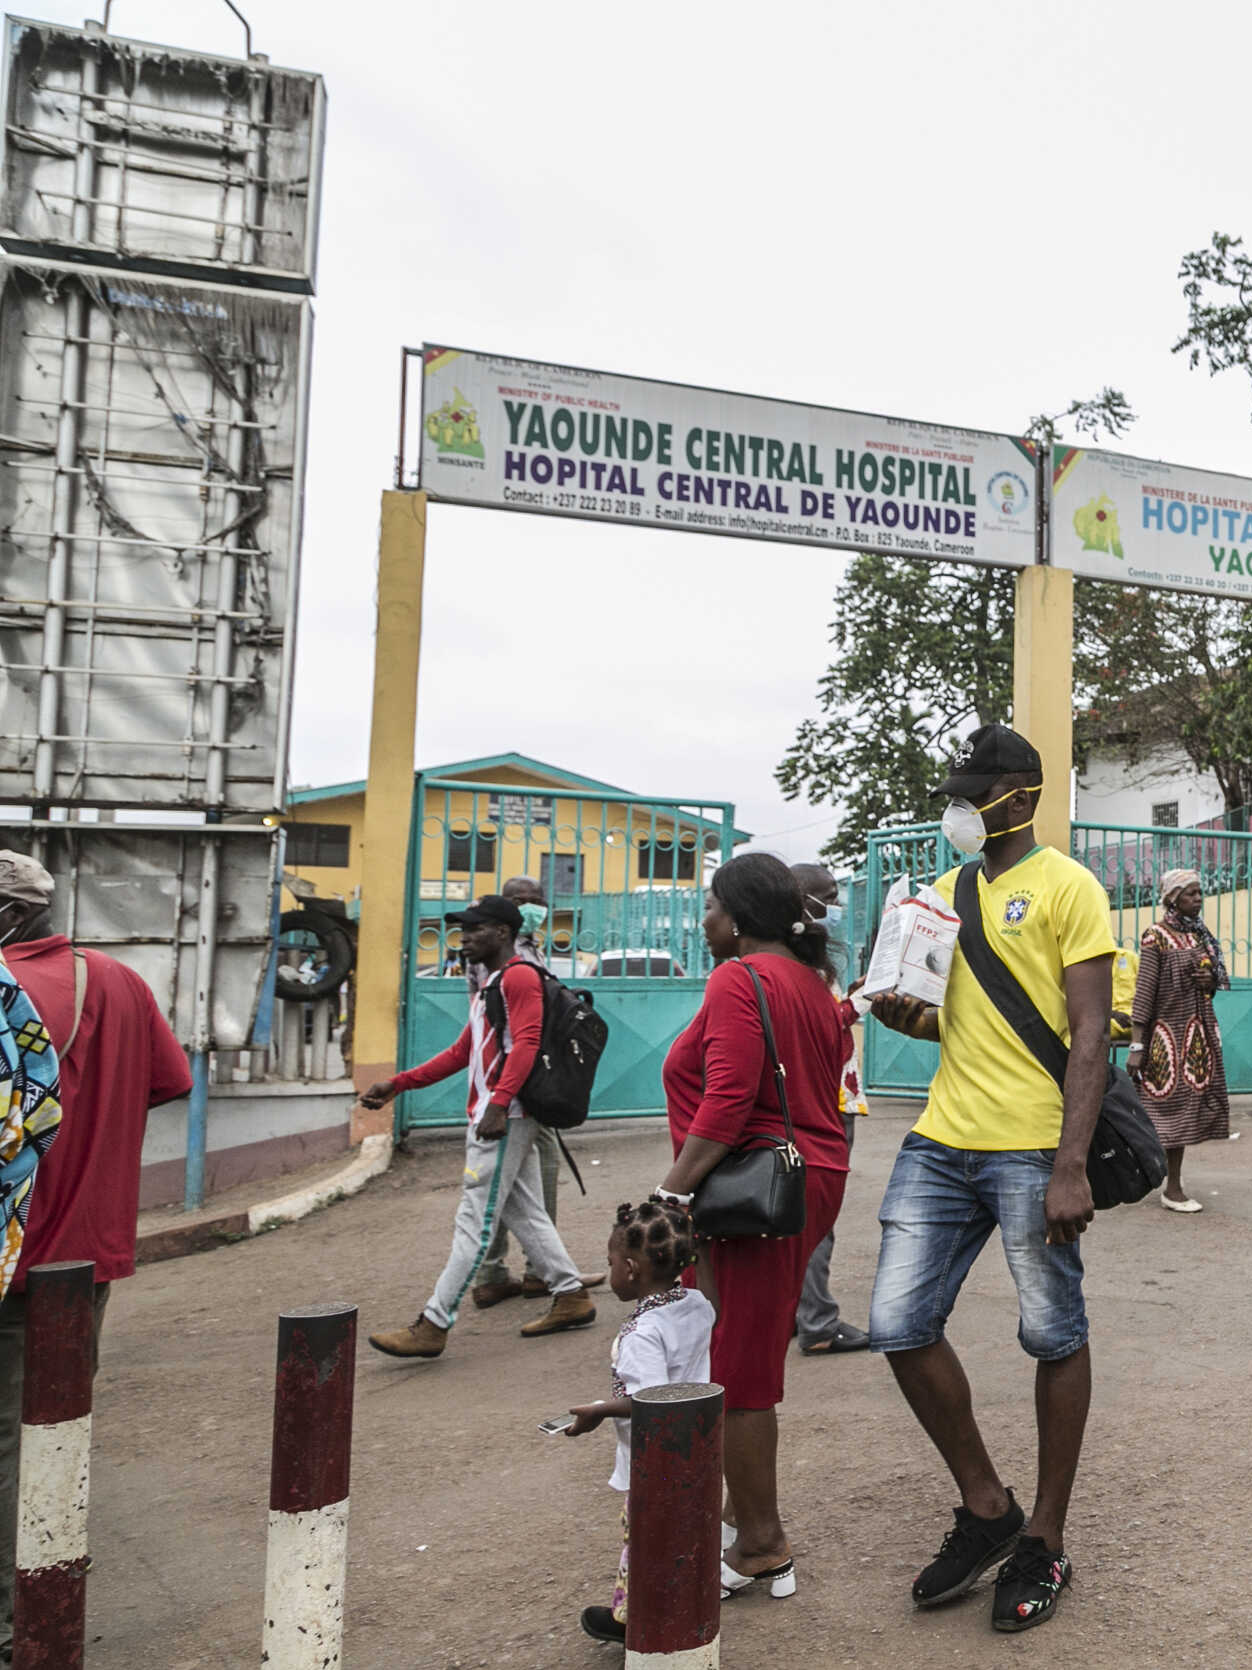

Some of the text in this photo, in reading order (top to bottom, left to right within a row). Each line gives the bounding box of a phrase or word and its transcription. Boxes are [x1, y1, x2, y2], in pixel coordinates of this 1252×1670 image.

[542, 392, 552, 402] OF
[555, 395, 585, 407] PUBLIC
[588, 399, 621, 411] HEALTH
[502, 400, 674, 467] YAOUNDE
[685, 427, 823, 486] CENTRAL
[836, 448, 976, 507] HOSPITAL
[504, 451, 976, 538] HOPITAL CENTRAL DE YAOUNDE
[1141, 484, 1185, 502] MINISTERE
[1187, 491, 1198, 504] DE
[1200, 493, 1210, 505] LA
[1212, 496, 1238, 509] SANTE
[655, 504, 684, 521] E-mail
[853, 529, 869, 544] Box
[934, 539, 975, 556] Cameroon
